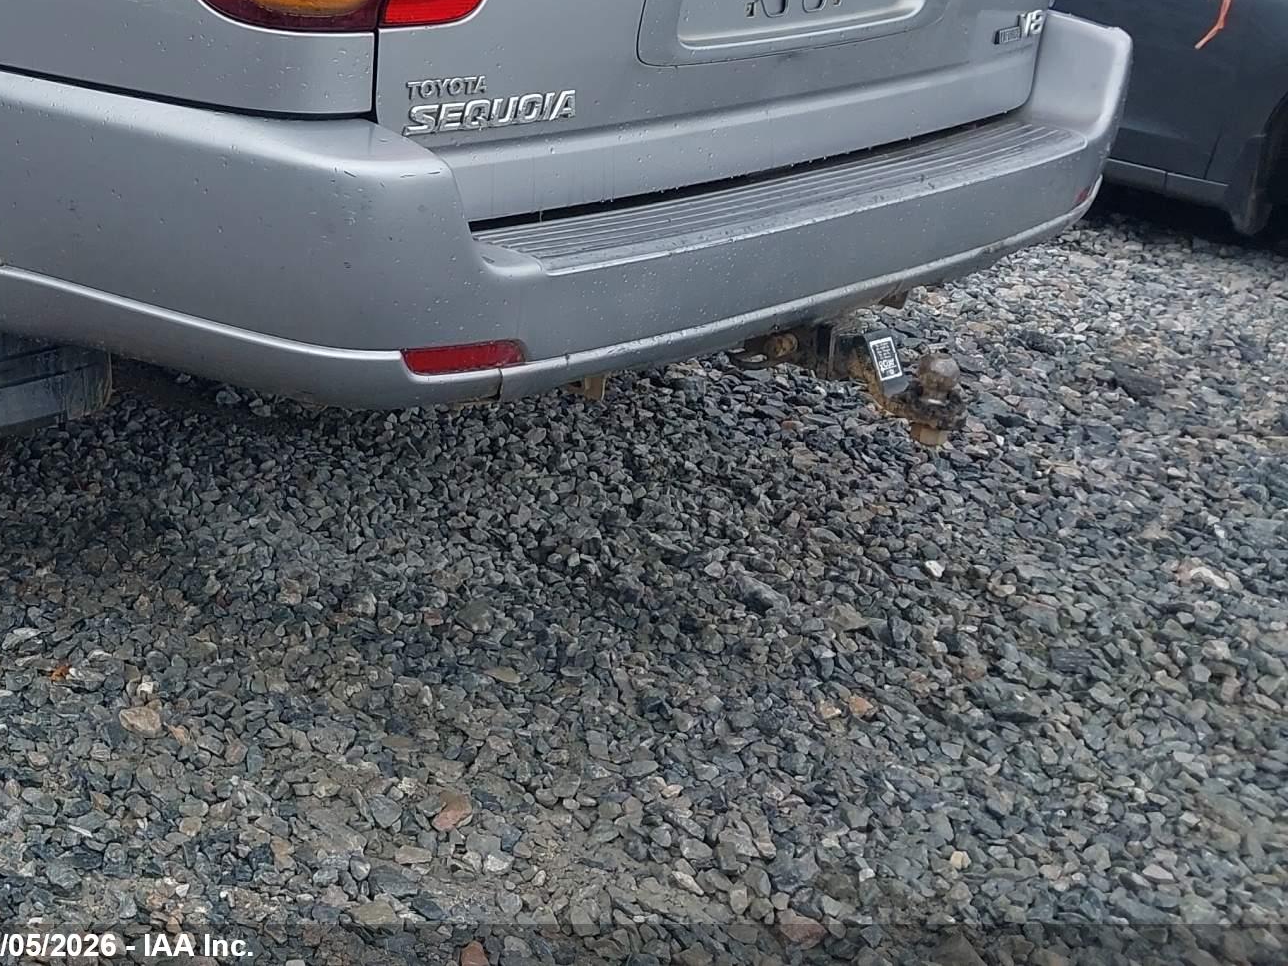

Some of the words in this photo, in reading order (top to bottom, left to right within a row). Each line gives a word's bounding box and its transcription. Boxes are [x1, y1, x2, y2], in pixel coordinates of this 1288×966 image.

[1020, 9, 1043, 37] V8
[406, 75, 487, 100] TOYOTA
[402, 89, 576, 136] SEQUOIA
